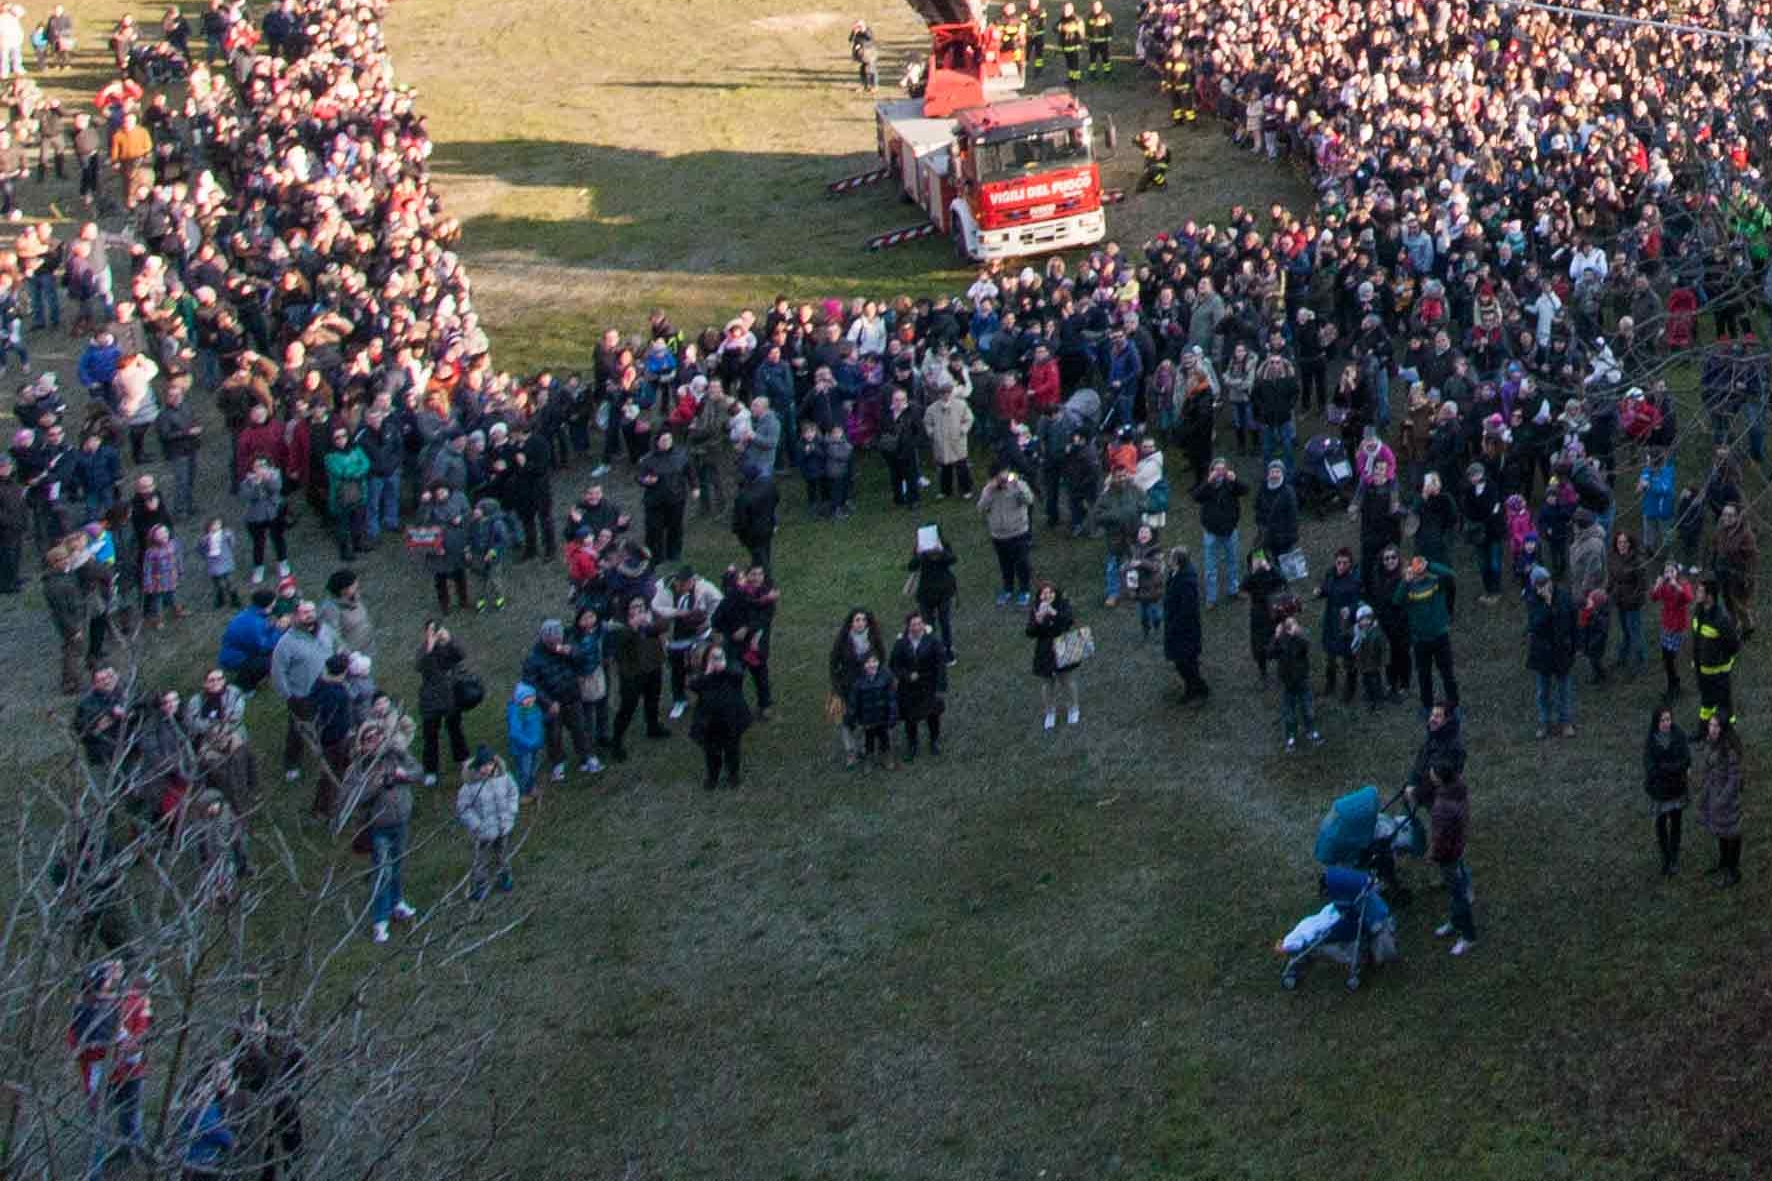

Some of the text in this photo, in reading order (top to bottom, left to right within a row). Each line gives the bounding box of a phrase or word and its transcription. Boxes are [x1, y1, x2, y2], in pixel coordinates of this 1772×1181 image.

[989, 189, 1025, 206] VIGILI
[1026, 183, 1051, 199] DEL
[1051, 175, 1093, 194] FUOCO
